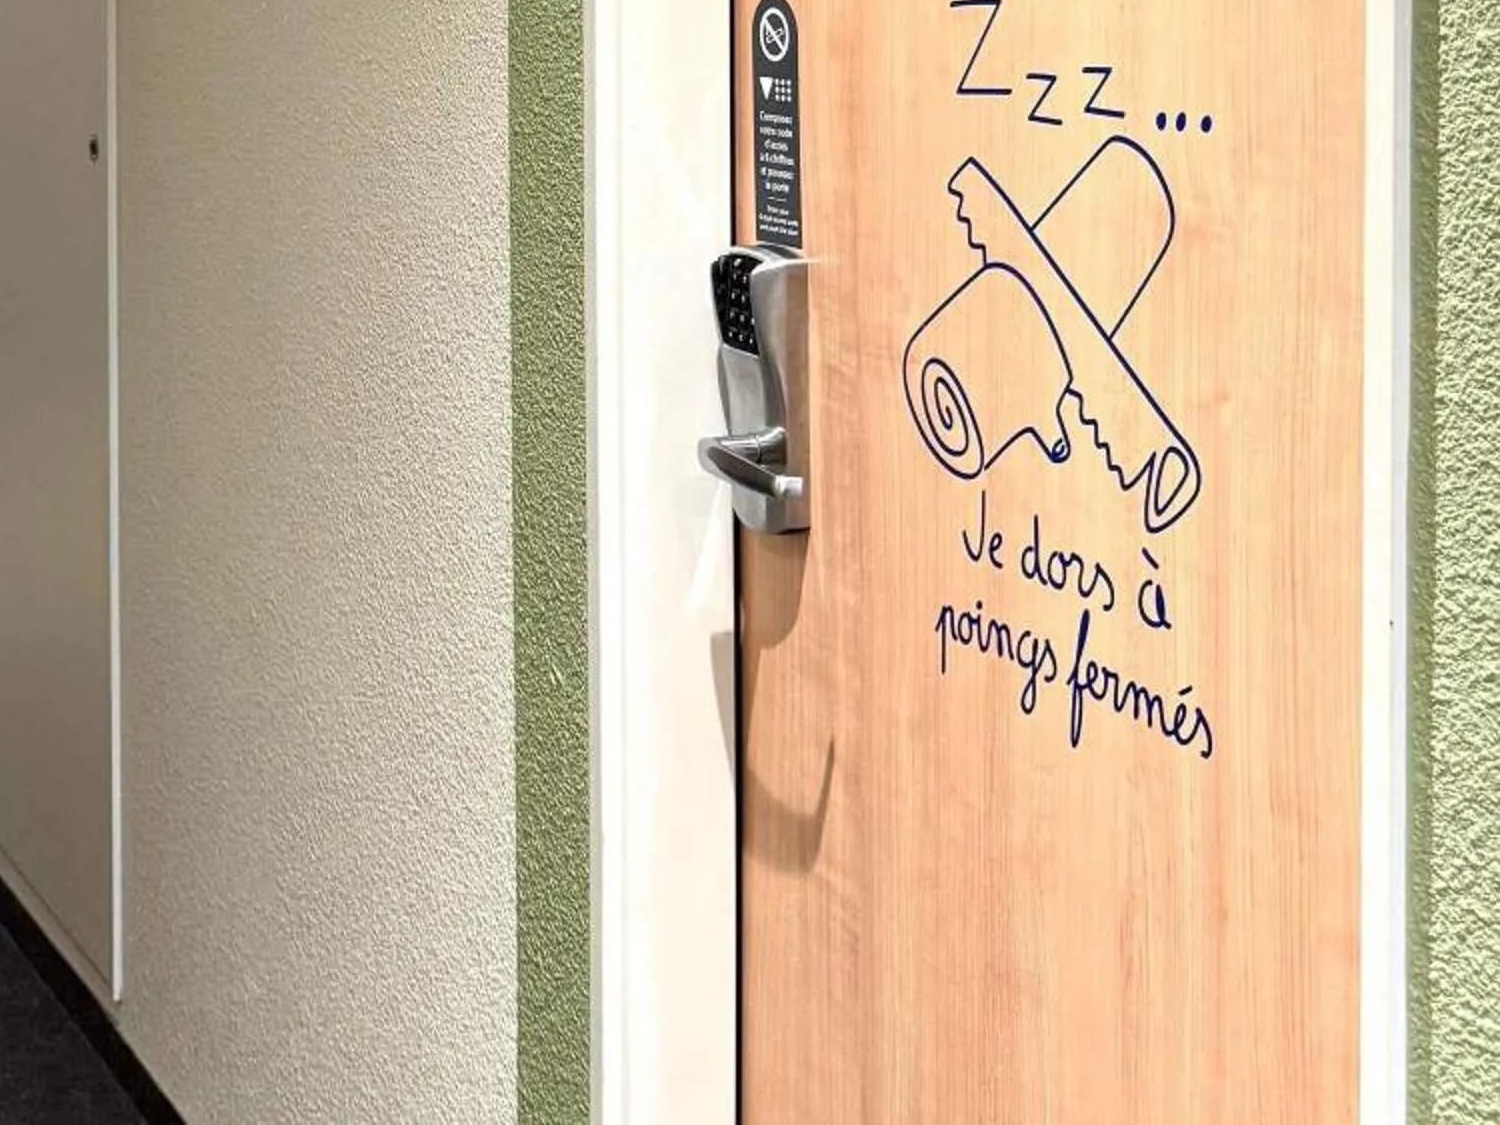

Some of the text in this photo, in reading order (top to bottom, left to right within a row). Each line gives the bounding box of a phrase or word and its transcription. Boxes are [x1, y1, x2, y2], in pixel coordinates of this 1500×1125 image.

[962, 490, 1172, 629] Je dors à
[935, 600, 1213, 759] poings fermés
